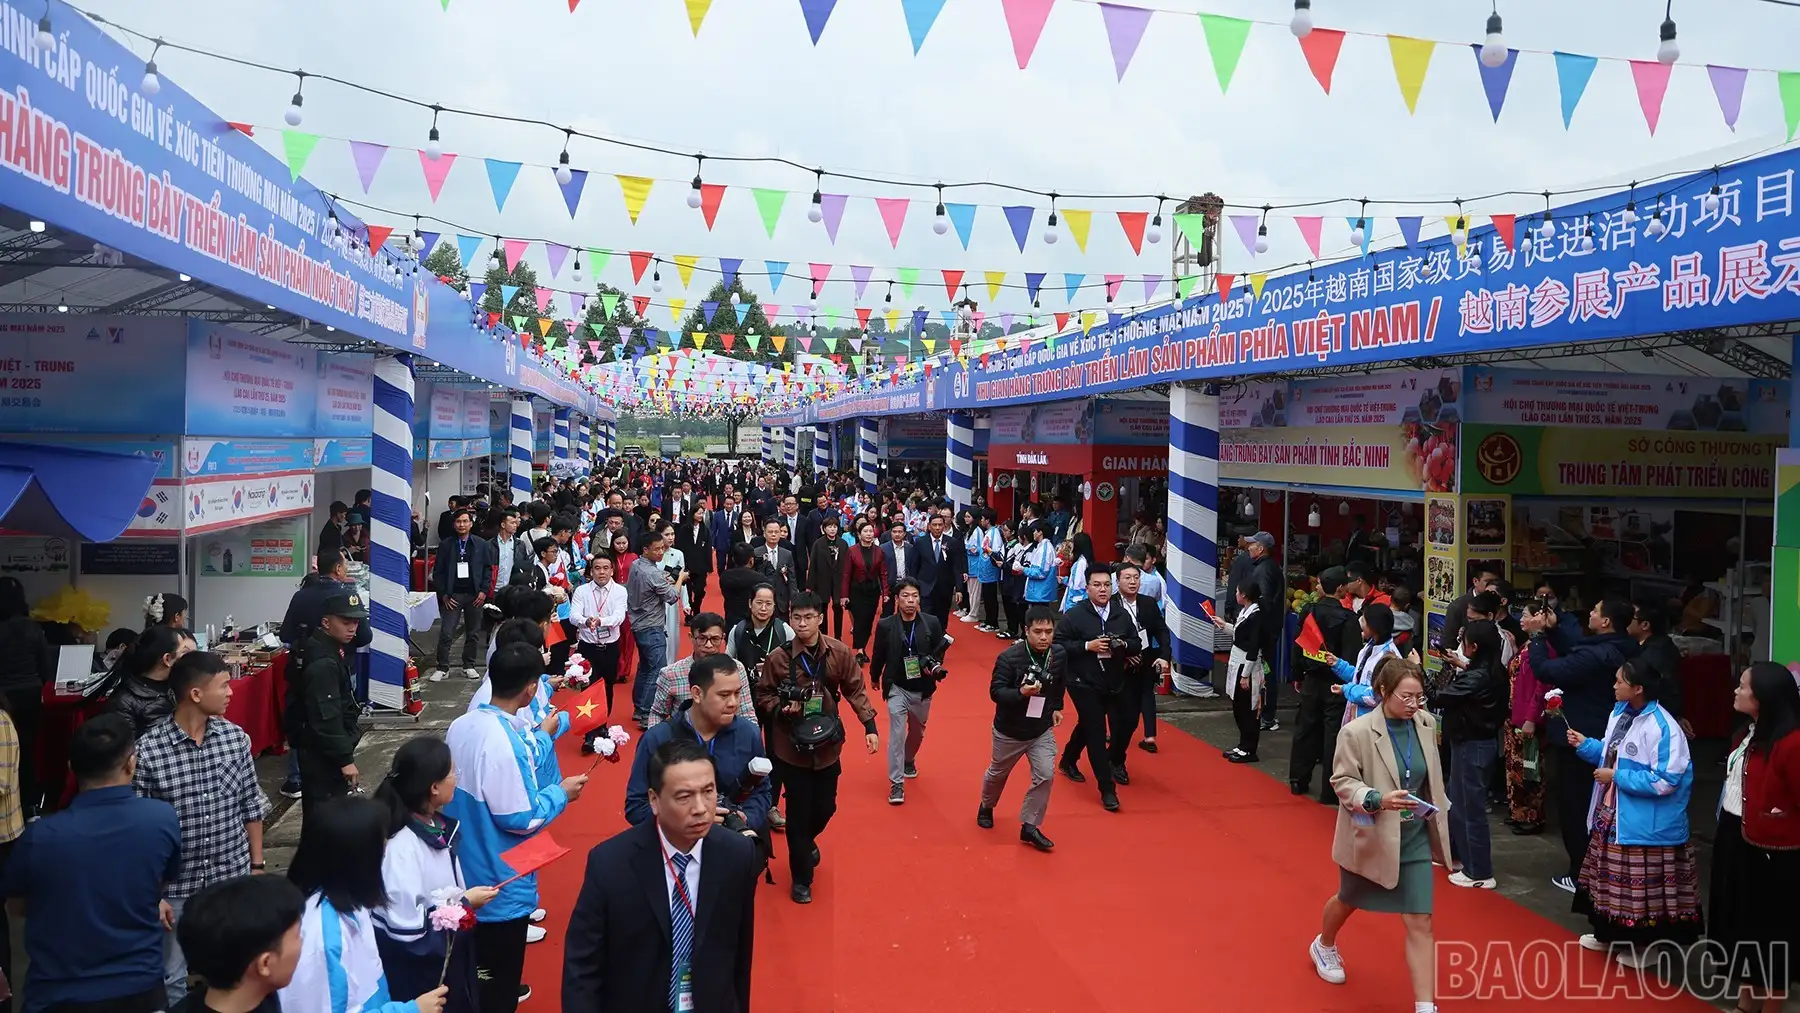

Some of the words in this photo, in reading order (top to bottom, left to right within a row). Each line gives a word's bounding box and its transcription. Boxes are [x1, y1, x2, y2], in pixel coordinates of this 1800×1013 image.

[45, 30, 81, 92] CẤP
[86, 61, 128, 124] QUỐC
[131, 92, 154, 141] GIA
[158, 104, 173, 151] VỀ
[175, 113, 199, 167] XÚC
[202, 136, 225, 183] TIẾN
[227, 153, 262, 205] THƯƠNG
[264, 178, 280, 219] MẠI
[280, 188, 298, 226] NĂM
[299, 203, 316, 237] 2025
[0, 86, 71, 194] HÀNG
[74, 132, 146, 228] TRƯNG
[146, 170, 184, 243] BÀY
[185, 190, 228, 263] TRIỂN
[228, 213, 258, 276] LÃM
[258, 223, 282, 285] SẢN
[282, 238, 311, 298] PHẨM
[311, 259, 335, 308] NƯỚC
[990, 379, 1009, 399] GIAN
[1009, 372, 1031, 398] HÀNG
[1032, 367, 1061, 395] TRƯNG
[1063, 360, 1083, 390] BÀY
[1084, 347, 1118, 387] TRIỂN
[1120, 345, 1149, 381] LÃM
[1150, 334, 1183, 374] SẢN
[1185, 322, 1236, 370] PHẨM
[1239, 318, 1289, 364] PHÍA
[1292, 309, 1346, 362] VIỆT
[1350, 300, 1421, 350] NAM
[1458, 236, 1800, 338] 越南参展产品展示
[1056, 345, 1068, 359] GIA
[1182, 305, 1210, 328] NĂM
[1212, 298, 1244, 321] 2025
[35, 360, 75, 373] TRUNG
[11, 378, 41, 390] 2025
[1519, 400, 1535, 413] CHỢ
[1536, 401, 1567, 412] THƯƠNG
[1569, 402, 1583, 415] MẠI
[1585, 402, 1606, 414] QUỐC
[1608, 400, 1616, 412] TẾ
[1618, 402, 1659, 415] VIỆT-TRUNG
[1558, 413, 1574, 424] LẦN
[1575, 413, 1590, 424] THỨ
[1605, 414, 1622, 425] NĂM
[1624, 415, 1642, 425] 2025
[1258, 439, 1274, 464] BÀY
[1275, 437, 1291, 464] SẢN
[1292, 437, 1317, 465] PHẨM
[1319, 438, 1339, 466] TỈNH
[1342, 436, 1361, 467] BẮC
[1364, 446, 1389, 468] NINH
[1629, 438, 1649, 454] SỞ
[1654, 438, 1695, 454] CÔNG
[1701, 441, 1761, 455] THƯƠNG
[1102, 456, 1138, 470] GIAN
[1559, 463, 1606, 486] TRUNG
[1611, 459, 1642, 487] TÂM
[1646, 459, 1683, 487] PHÁT
[1687, 457, 1727, 487] TRIỂN
[1732, 460, 1769, 488] CÔNG
